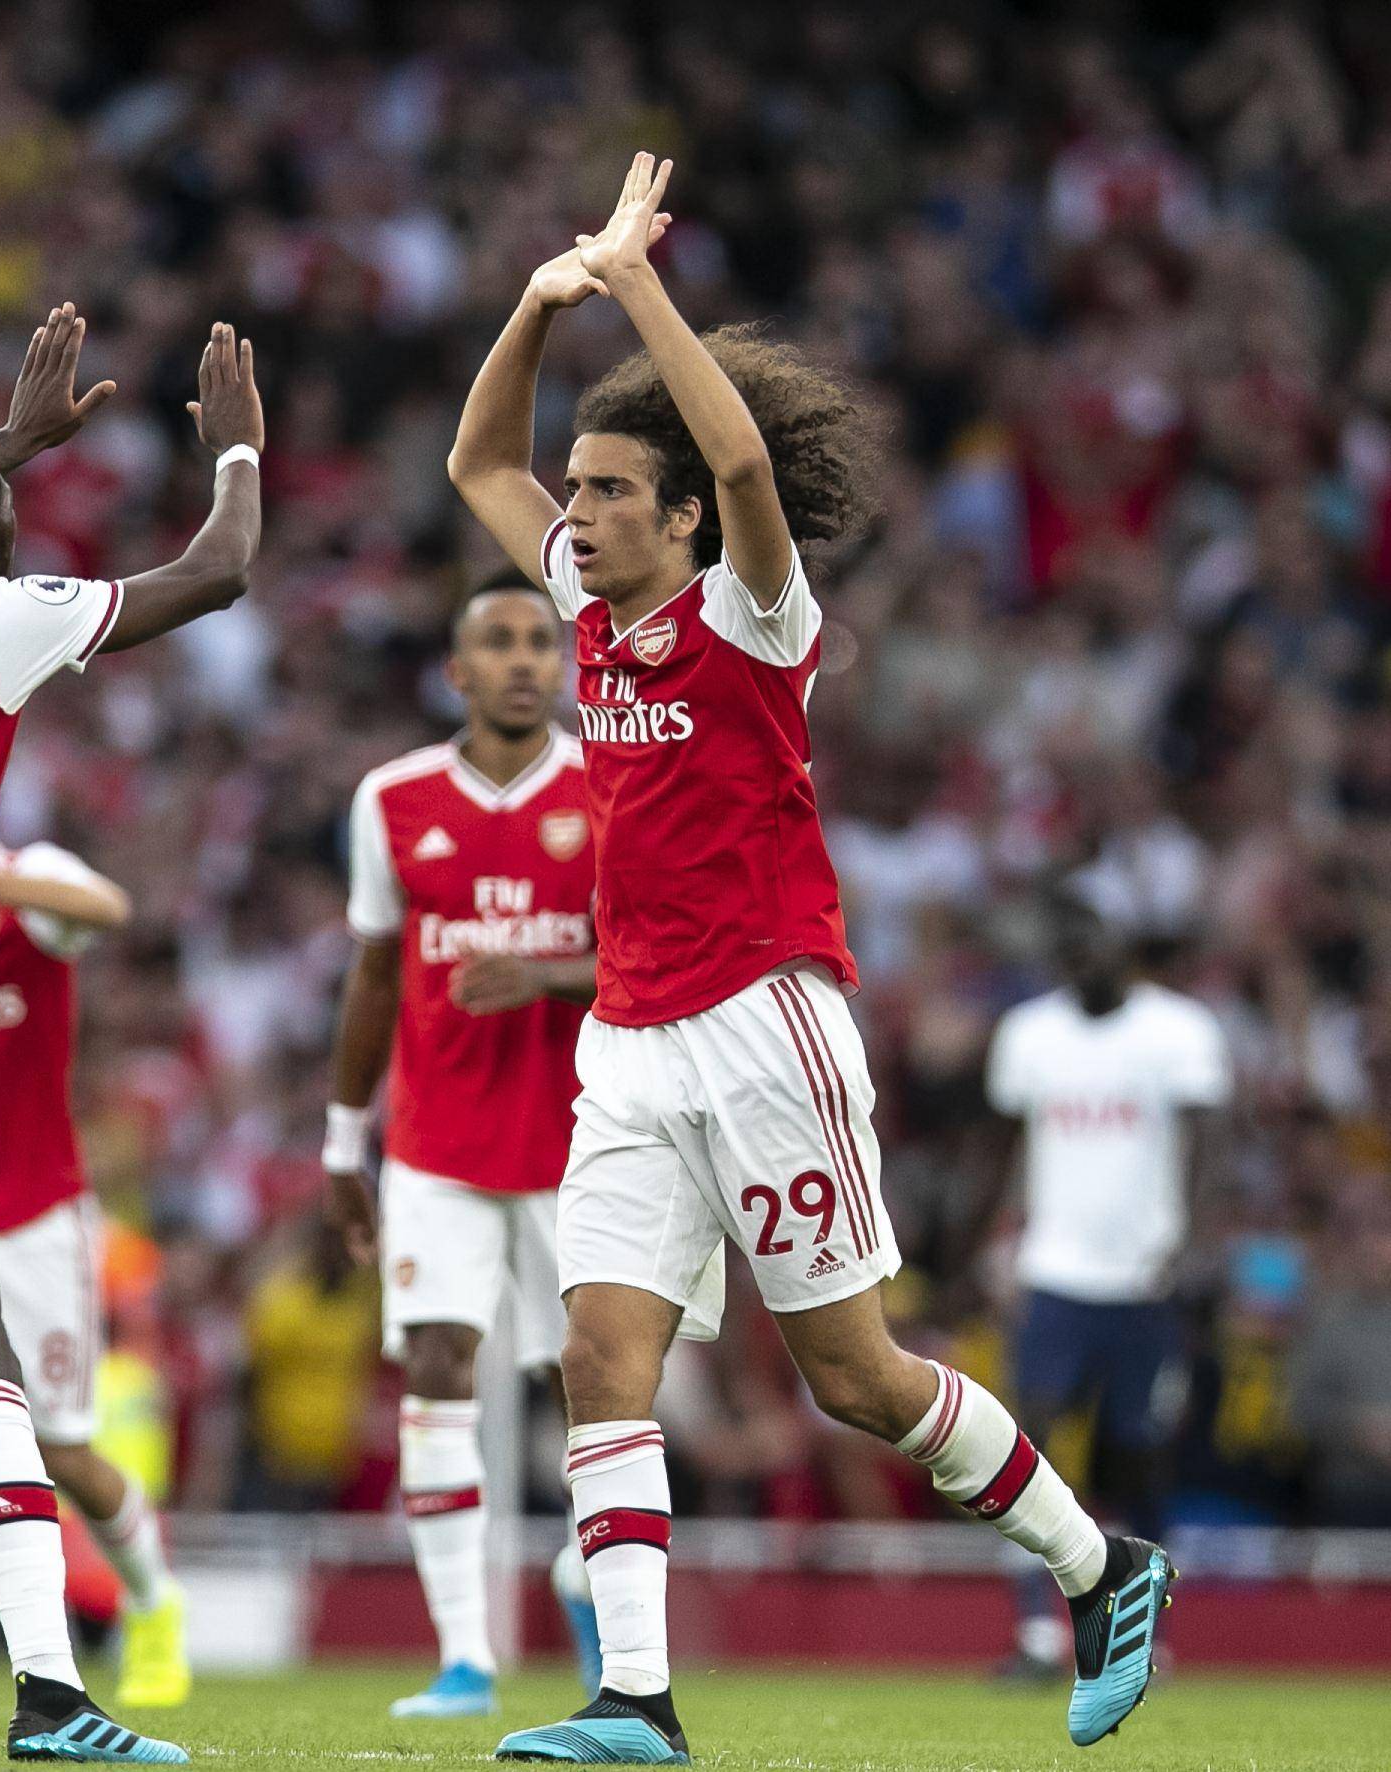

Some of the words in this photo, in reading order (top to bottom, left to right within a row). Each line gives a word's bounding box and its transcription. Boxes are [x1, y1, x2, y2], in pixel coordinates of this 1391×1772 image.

[636, 622, 671, 638] Arsenal
[577, 697, 694, 743] mirates
[740, 1169, 837, 1256] 29
[805, 1260, 847, 1280] adidas
